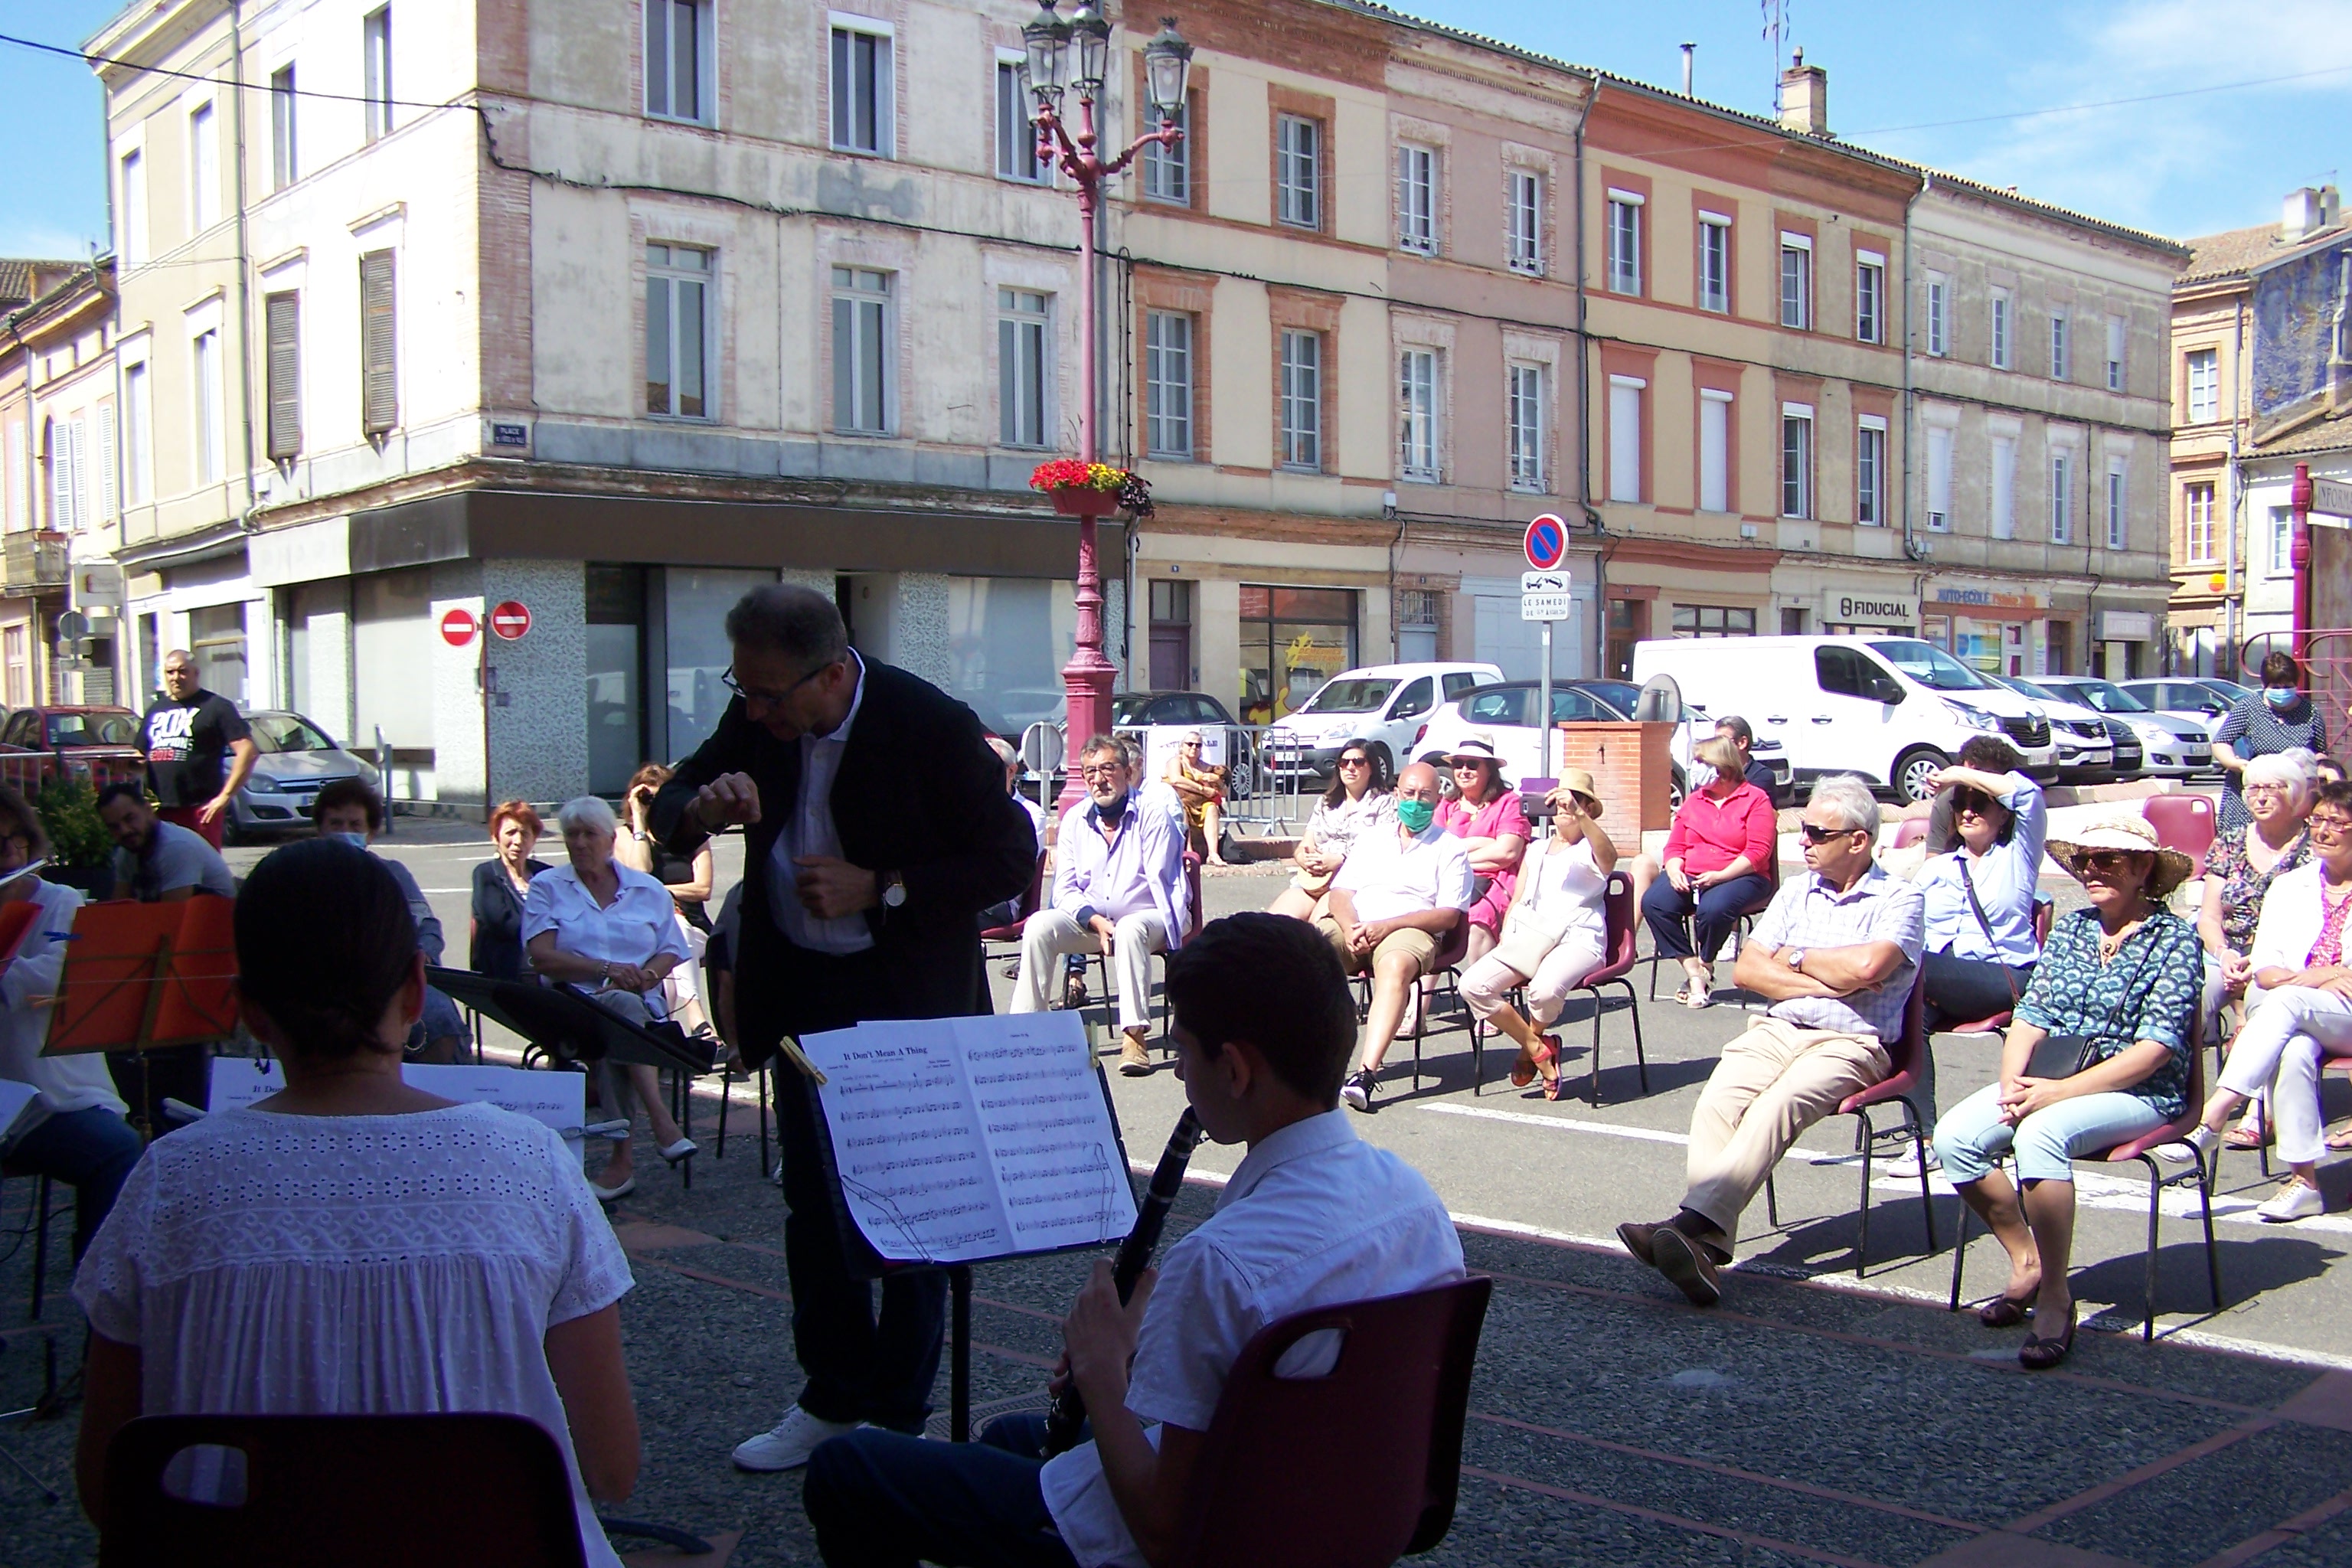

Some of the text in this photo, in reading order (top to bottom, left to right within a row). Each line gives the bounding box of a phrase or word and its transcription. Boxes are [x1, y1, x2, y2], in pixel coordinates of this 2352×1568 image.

[2318, 485, 2352, 510] INFORM
[1854, 601, 1909, 617] FIDUCIAL
[149, 707, 201, 737] 20X
[843, 1053, 851, 1061] It
[852, 1050, 873, 1060] Don't
[875, 1049, 896, 1058] Mean
[905, 1047, 928, 1056] Thing
